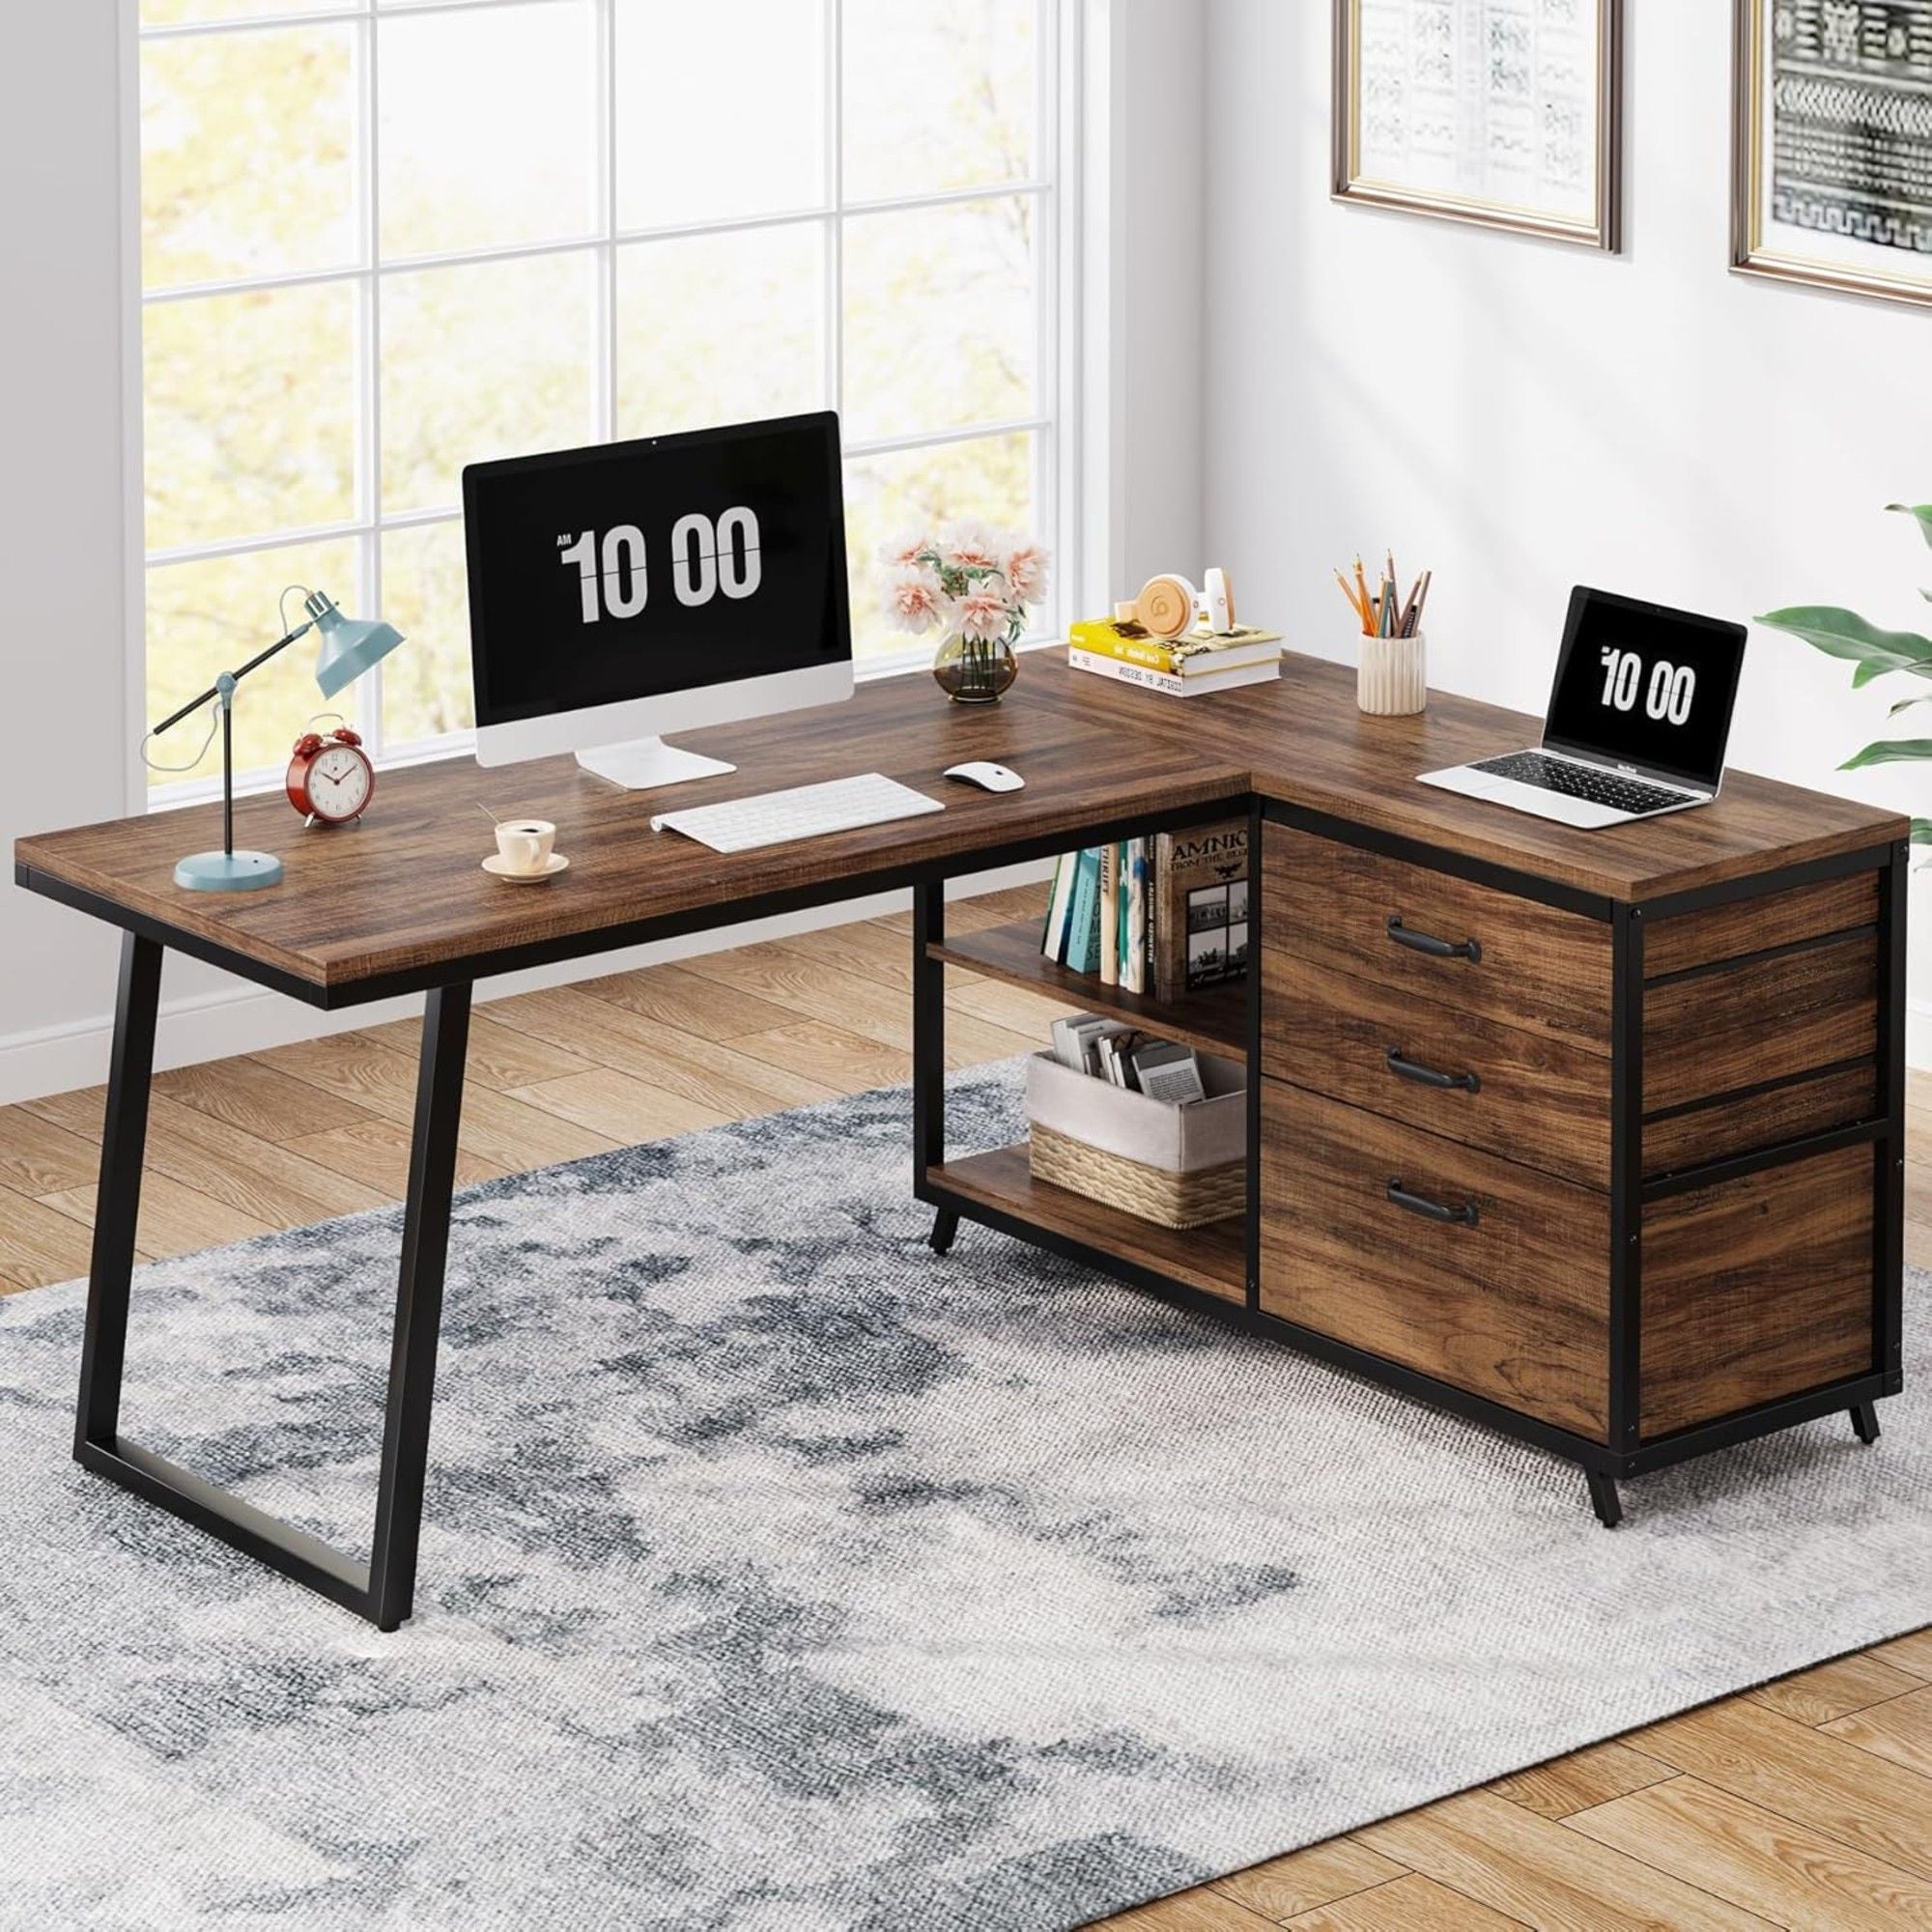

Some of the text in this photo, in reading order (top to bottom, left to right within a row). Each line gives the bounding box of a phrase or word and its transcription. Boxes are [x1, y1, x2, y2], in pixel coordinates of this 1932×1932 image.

[556, 533, 572, 546] AM
[560, 506, 762, 623] 10 00
[1601, 647, 1696, 725] 10 00
